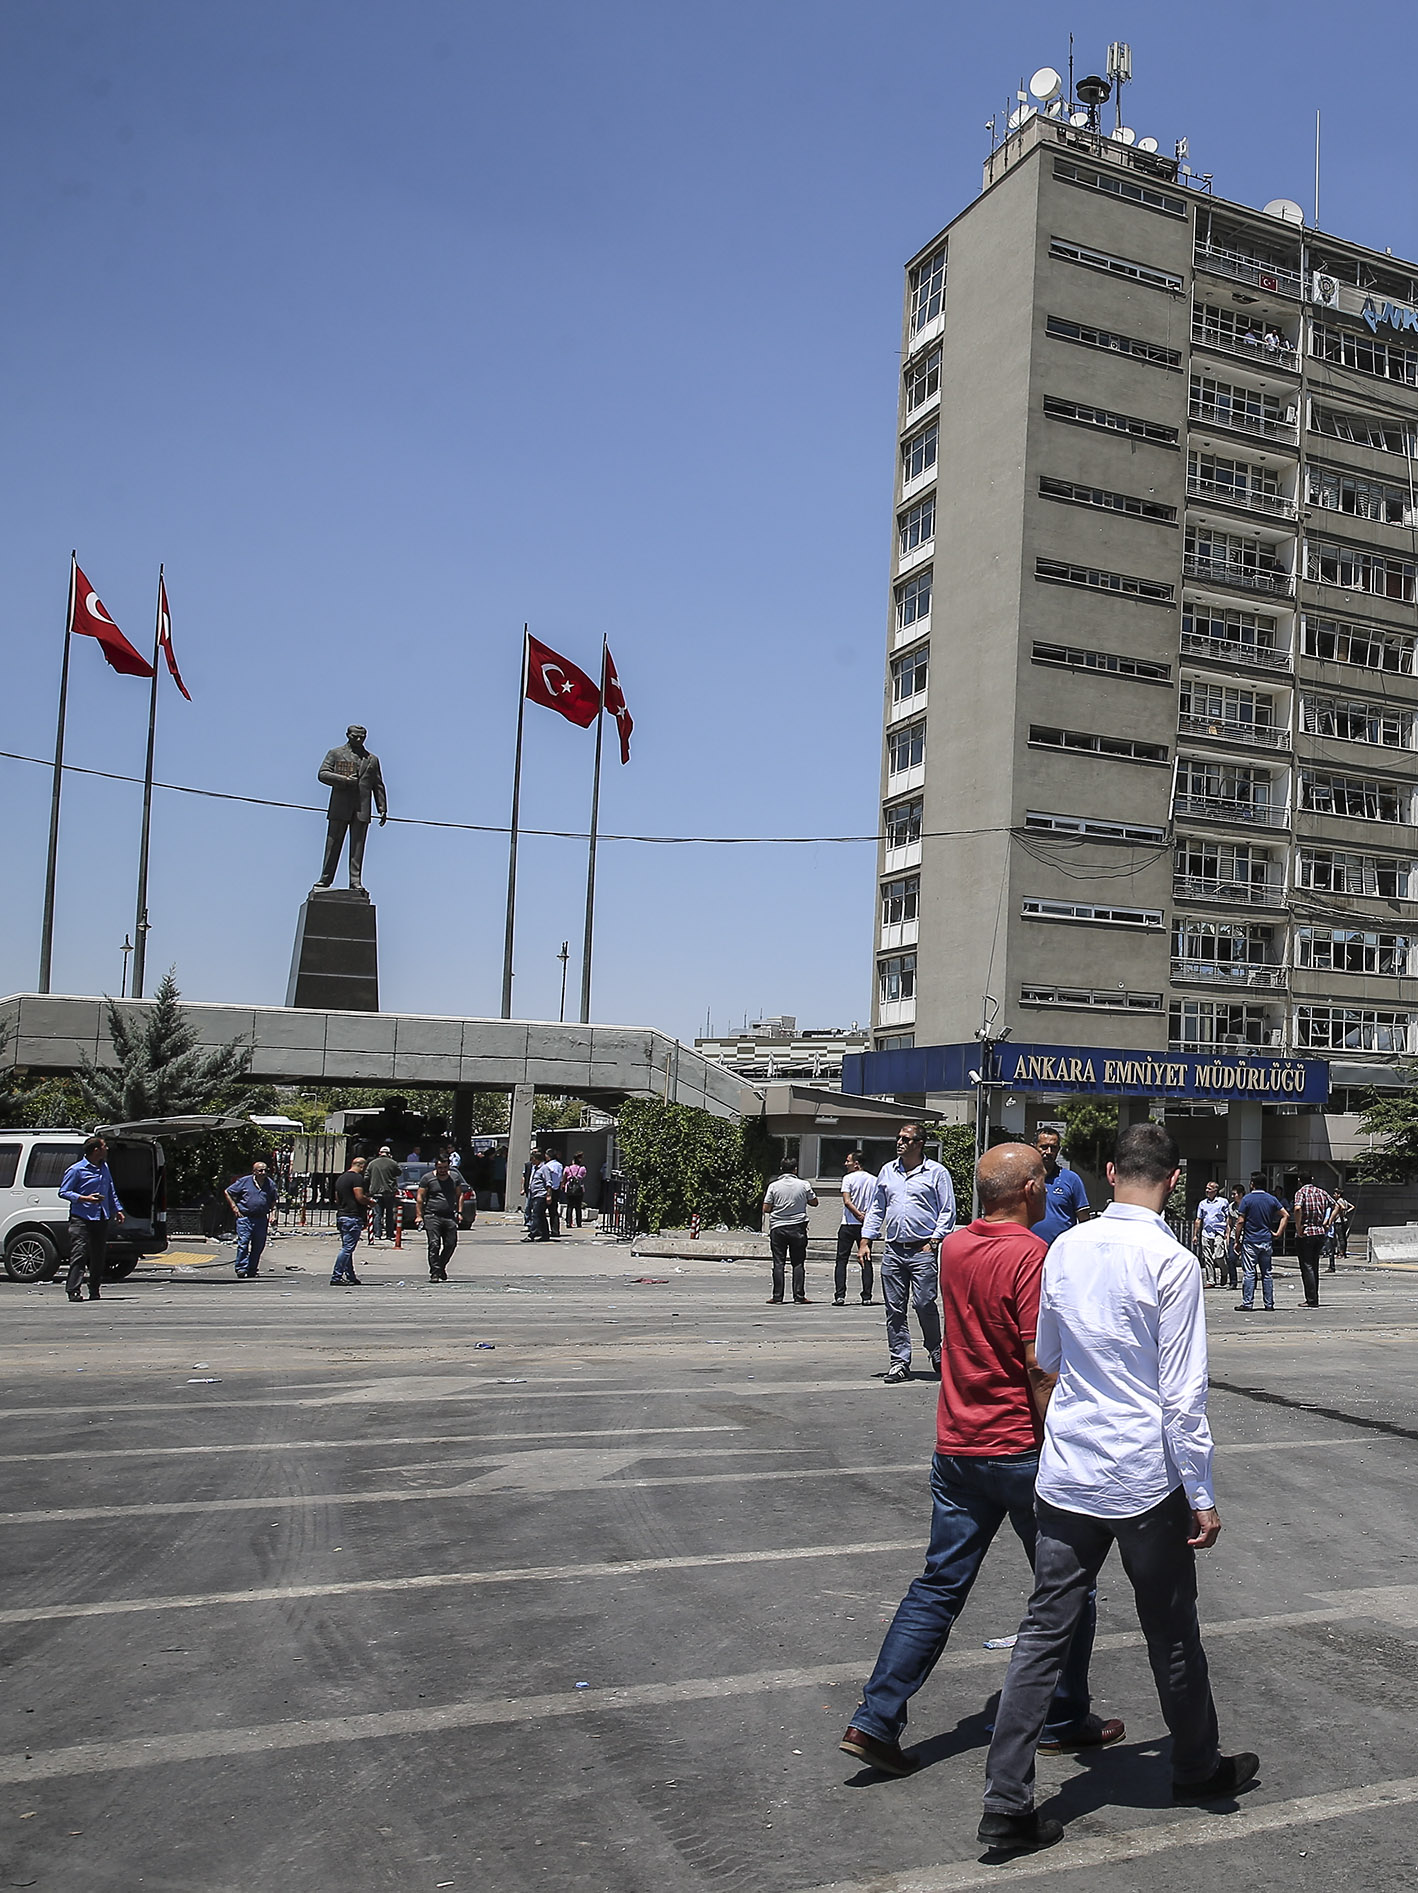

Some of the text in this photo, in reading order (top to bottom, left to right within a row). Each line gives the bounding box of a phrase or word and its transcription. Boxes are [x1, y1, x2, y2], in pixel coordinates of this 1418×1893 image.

[1013, 1055, 1306, 1092] ANKARA EMNİYET MÜDÜRLÜĞÜ
